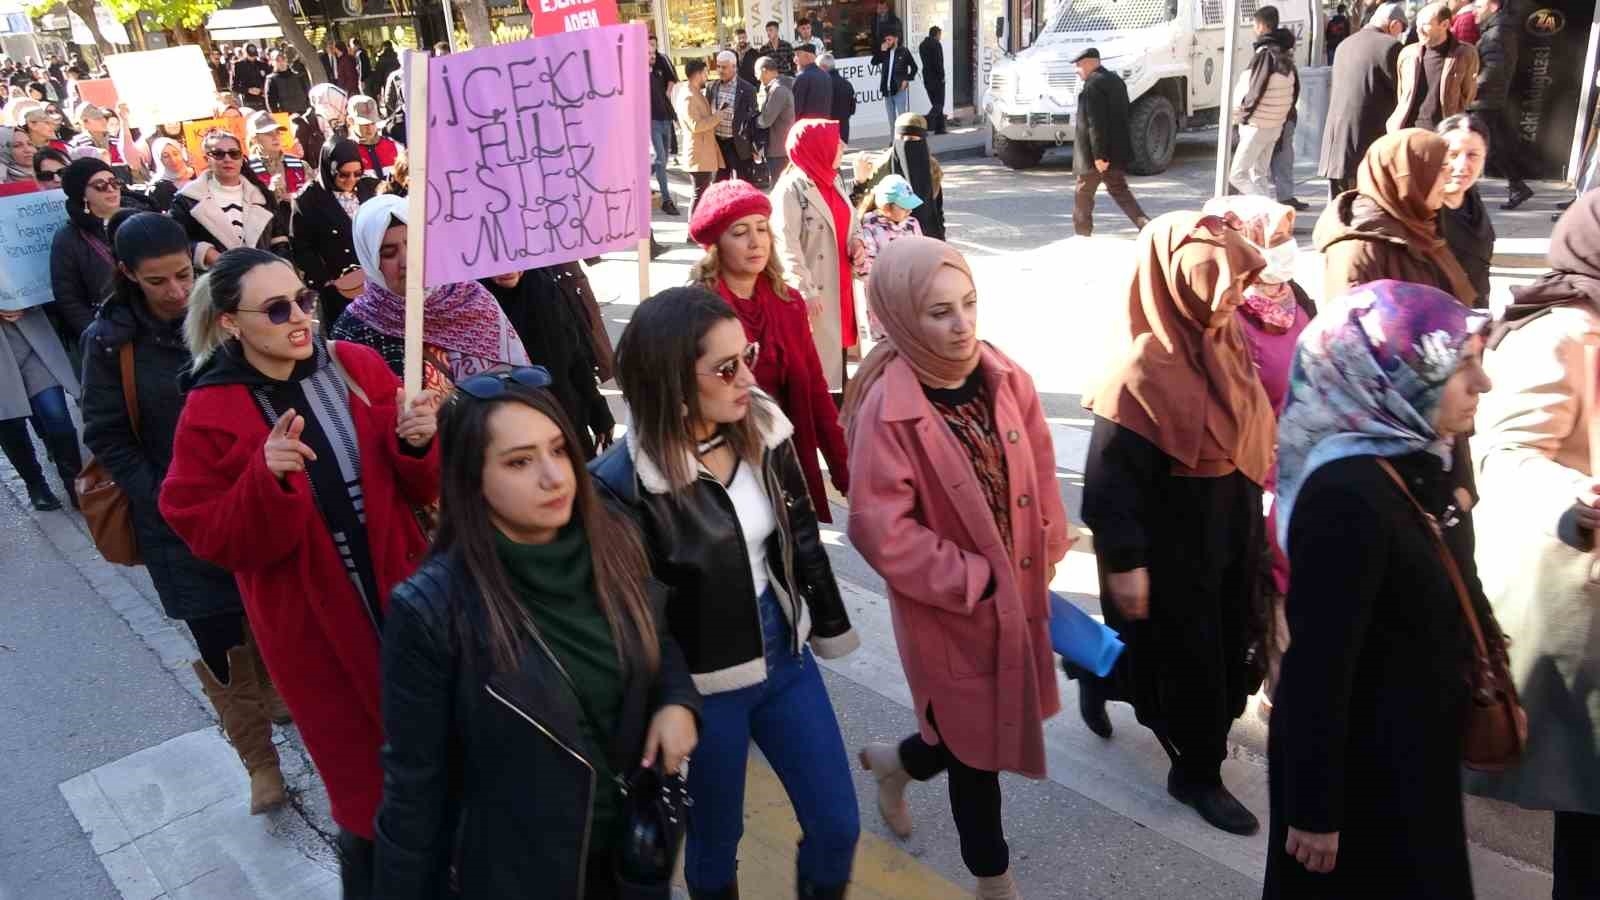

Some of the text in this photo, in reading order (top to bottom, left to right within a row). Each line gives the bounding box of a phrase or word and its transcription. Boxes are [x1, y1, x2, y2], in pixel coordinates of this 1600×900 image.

[564, 9, 599, 32] ADEM
[430, 34, 625, 127] İÇEKLİ
[836, 65, 864, 80] EPE
